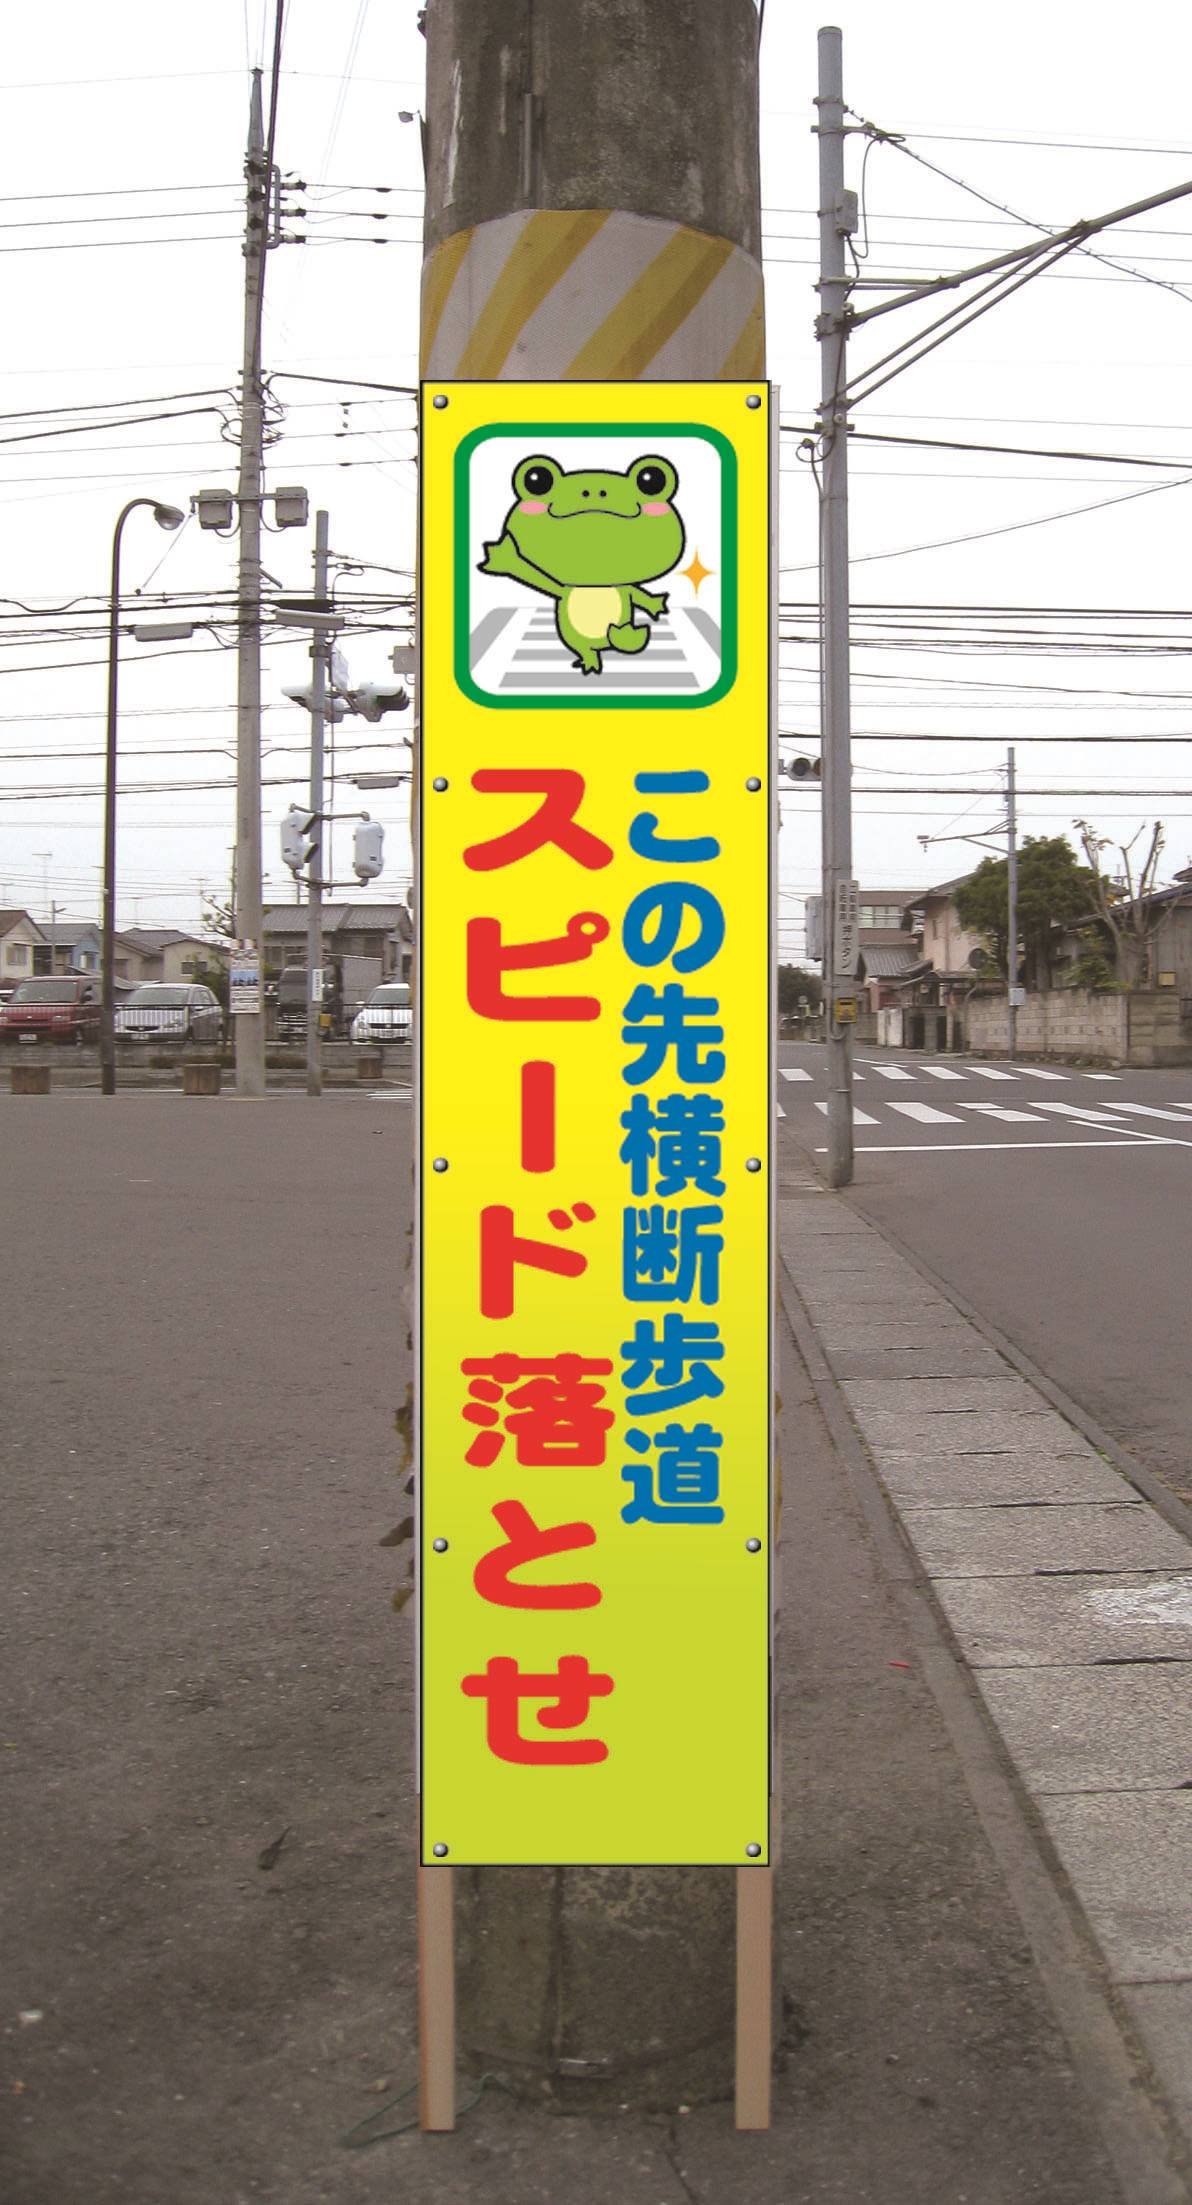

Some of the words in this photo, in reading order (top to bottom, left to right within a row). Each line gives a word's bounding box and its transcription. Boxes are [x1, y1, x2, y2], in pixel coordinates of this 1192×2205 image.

[462, 769, 615, 1765] スピード落とせ
[620, 770, 726, 1524] この先横断歩道
